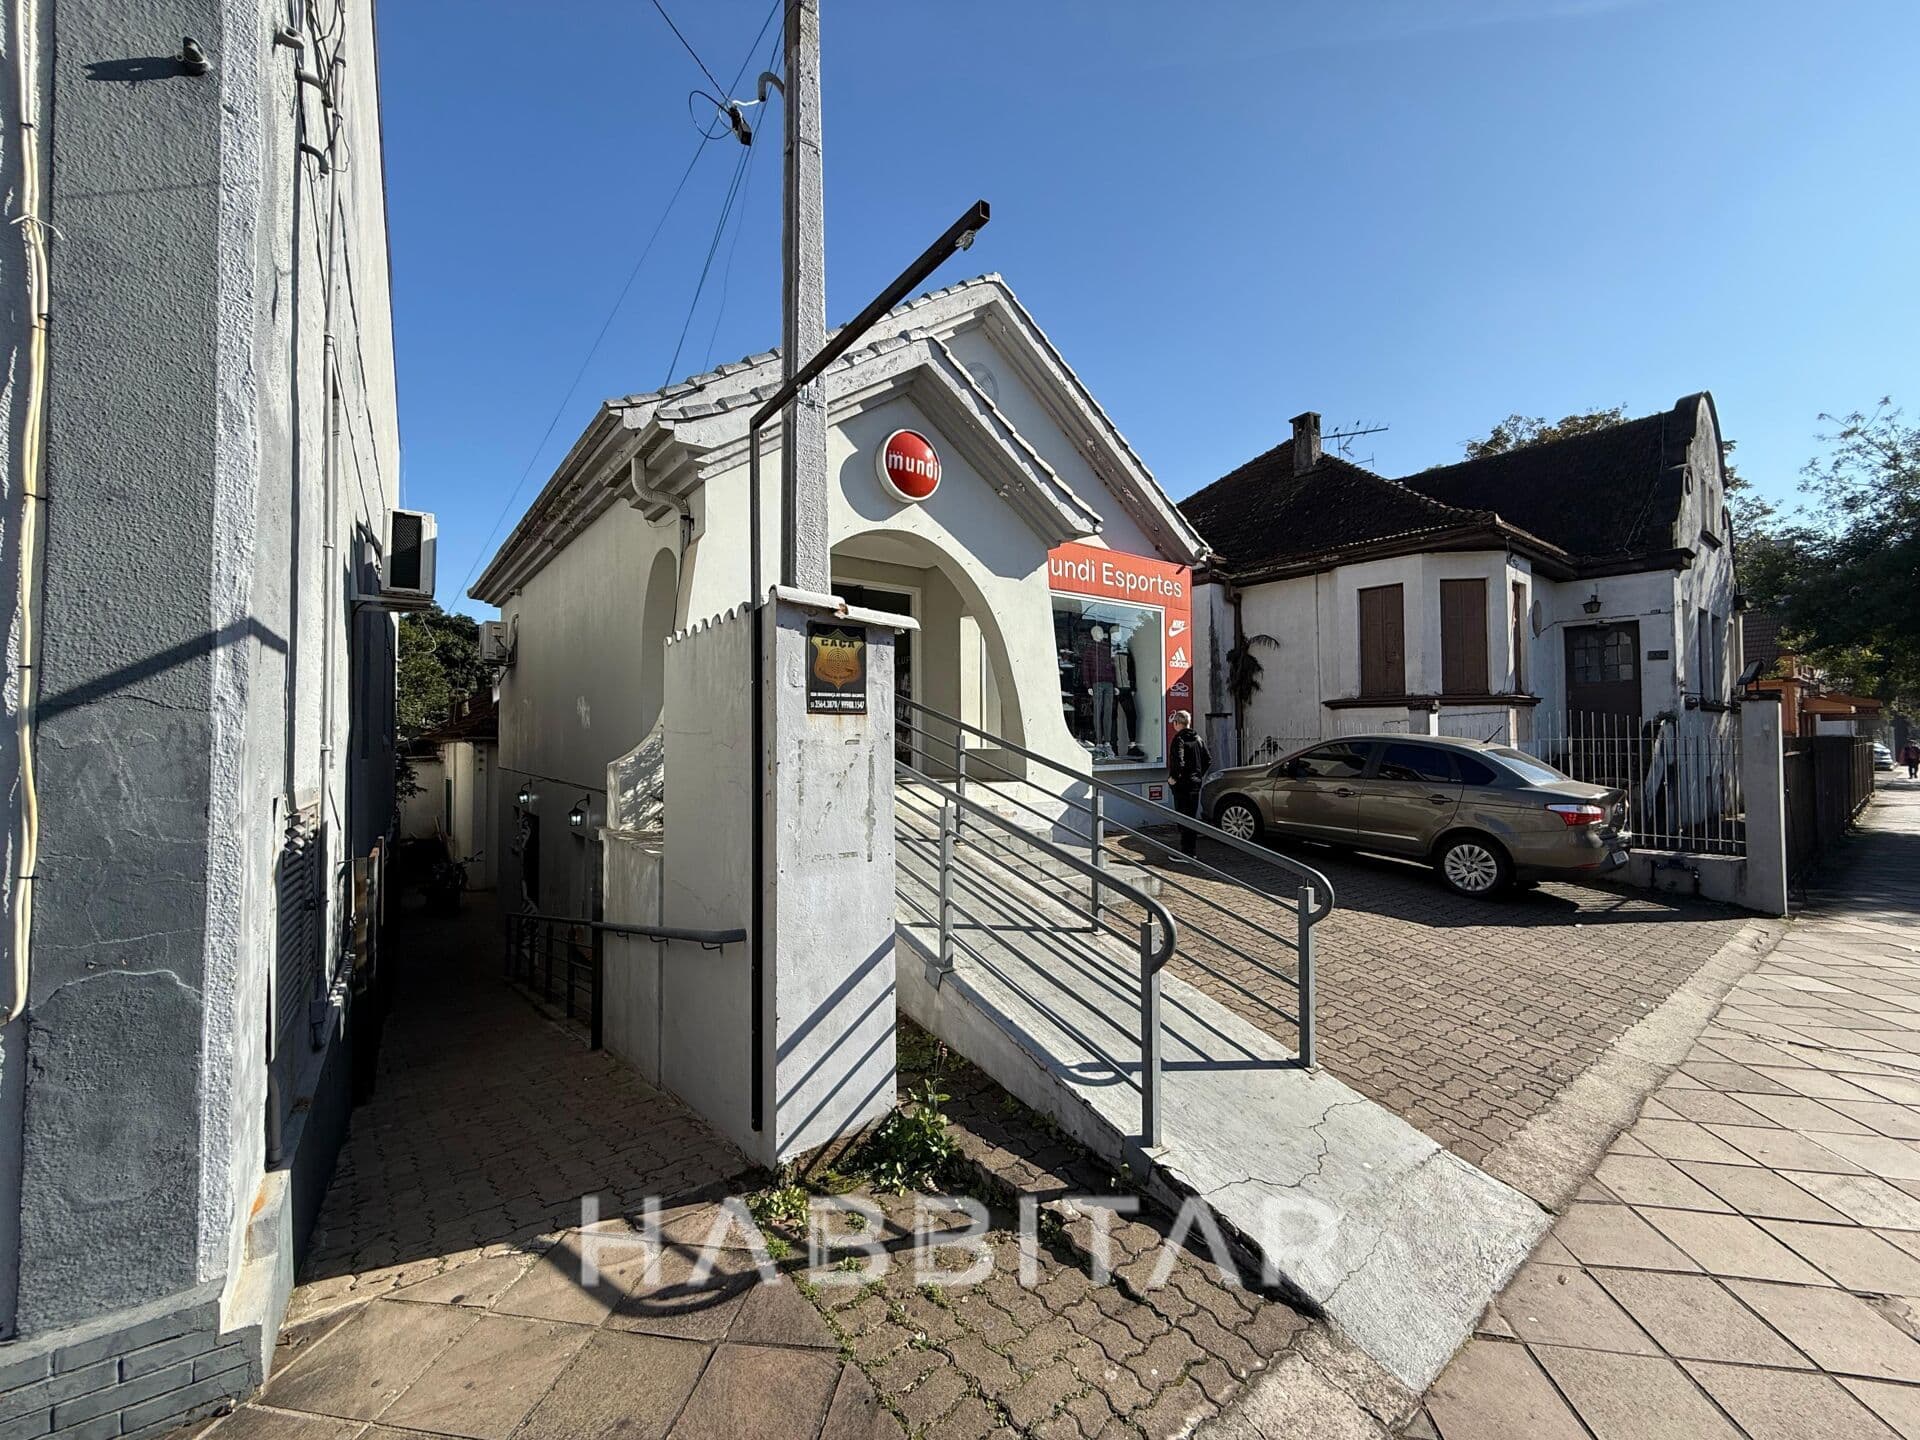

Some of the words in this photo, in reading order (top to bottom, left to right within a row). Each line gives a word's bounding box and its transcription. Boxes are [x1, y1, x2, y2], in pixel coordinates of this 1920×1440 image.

[888, 451, 938, 481] mundi
[1050, 558, 1096, 583] undi
[1102, 562, 1182, 597] Esportes
[821, 639, 855, 648] CAÇA
